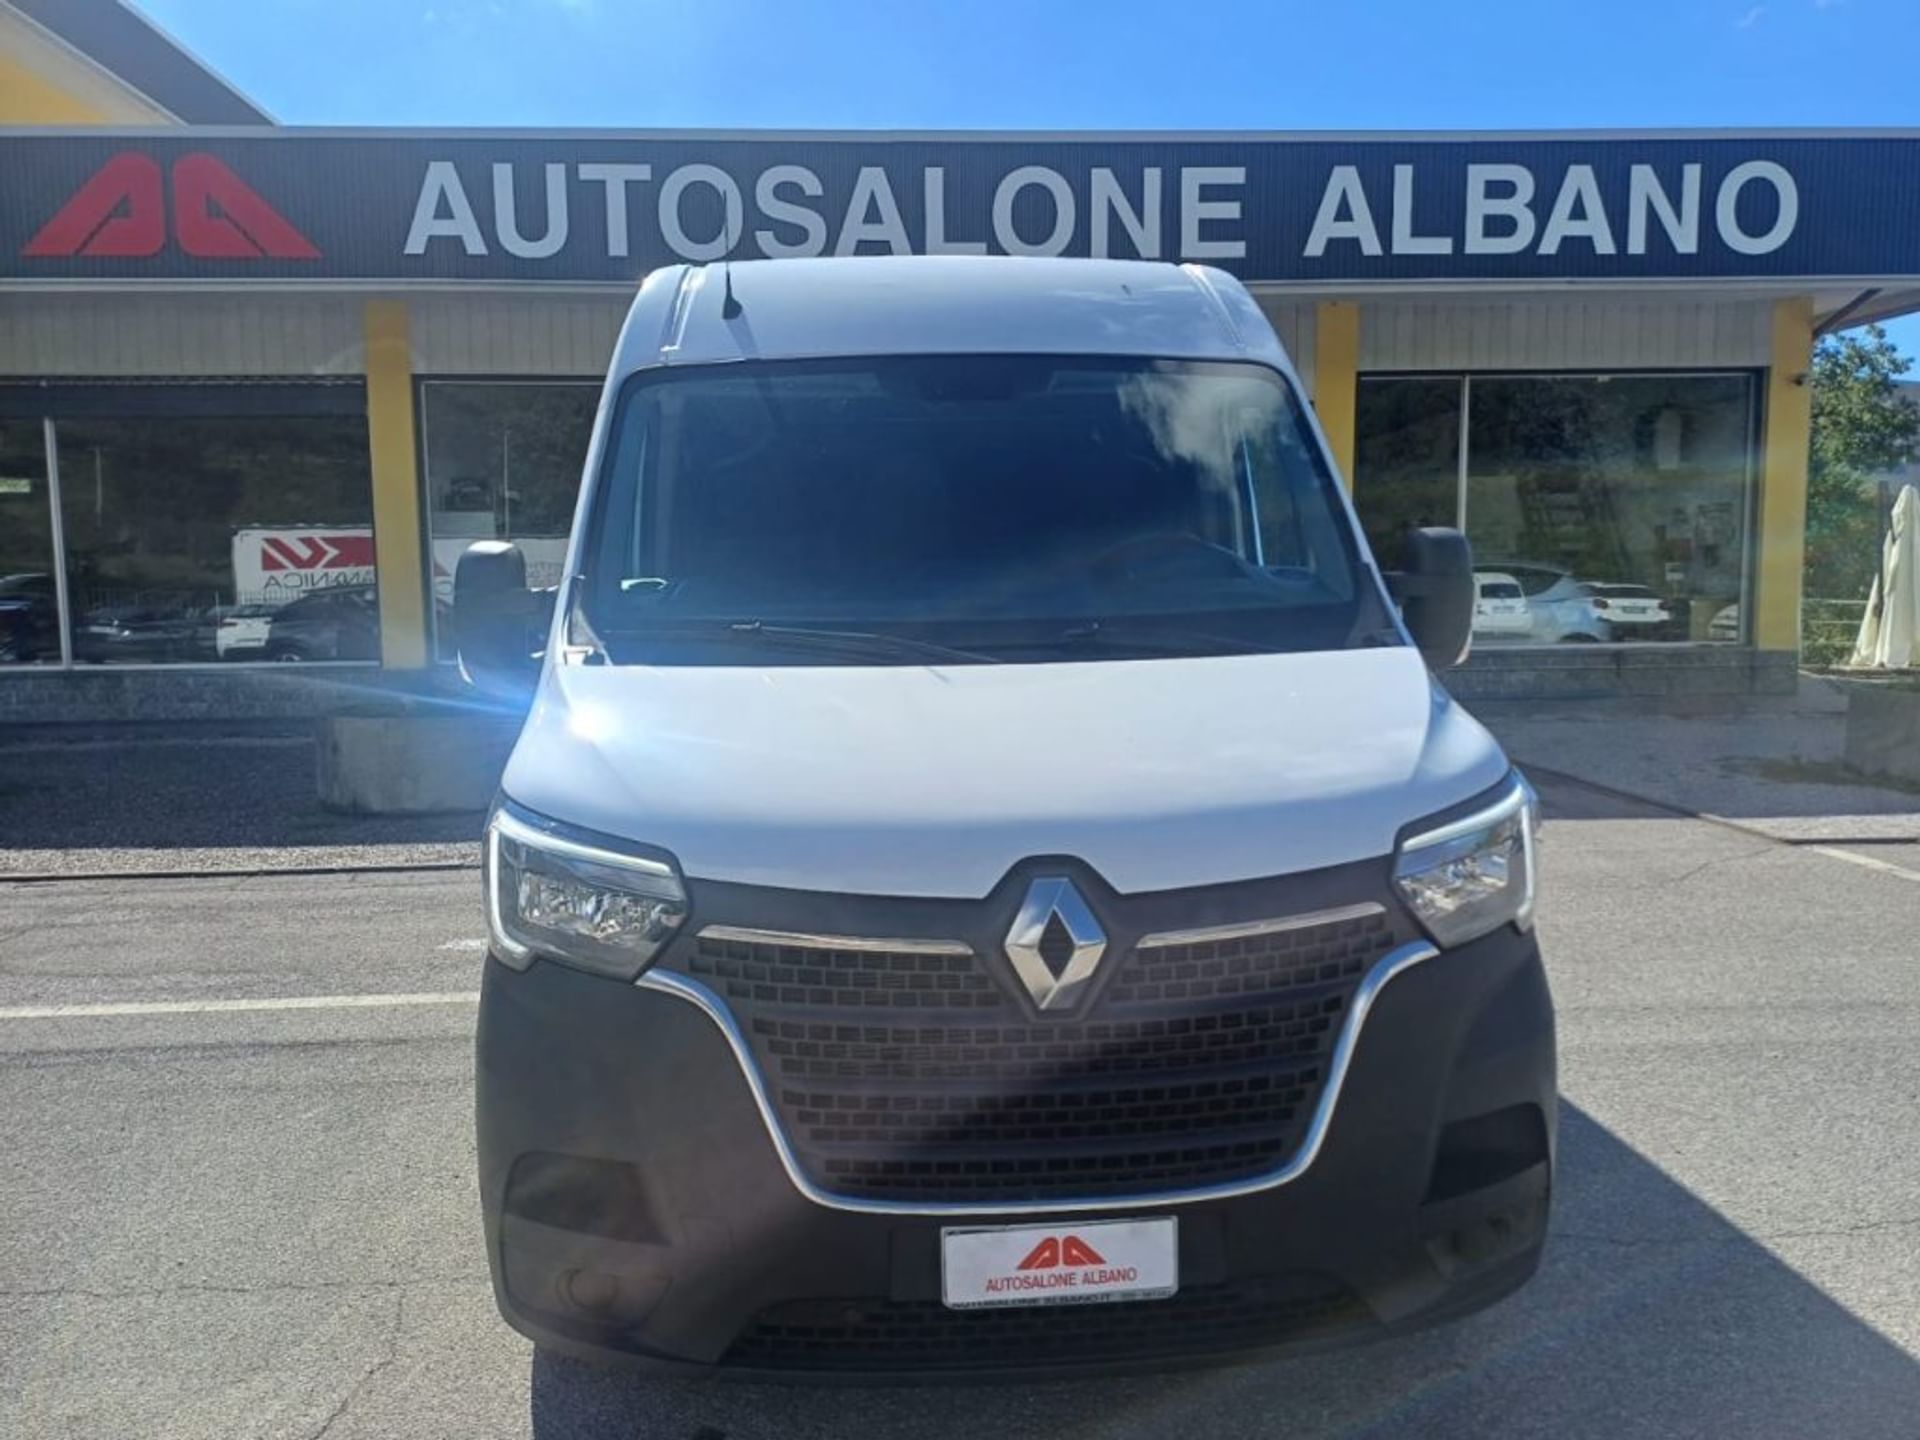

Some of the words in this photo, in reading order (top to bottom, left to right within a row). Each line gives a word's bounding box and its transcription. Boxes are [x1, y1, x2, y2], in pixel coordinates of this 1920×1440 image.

[402, 159, 1248, 262] AUTOSALONE
[1303, 159, 1799, 257] ALBANO
[985, 1272, 1077, 1292] AUTOSALONE
[1082, 1267, 1137, 1286] ALBANO
